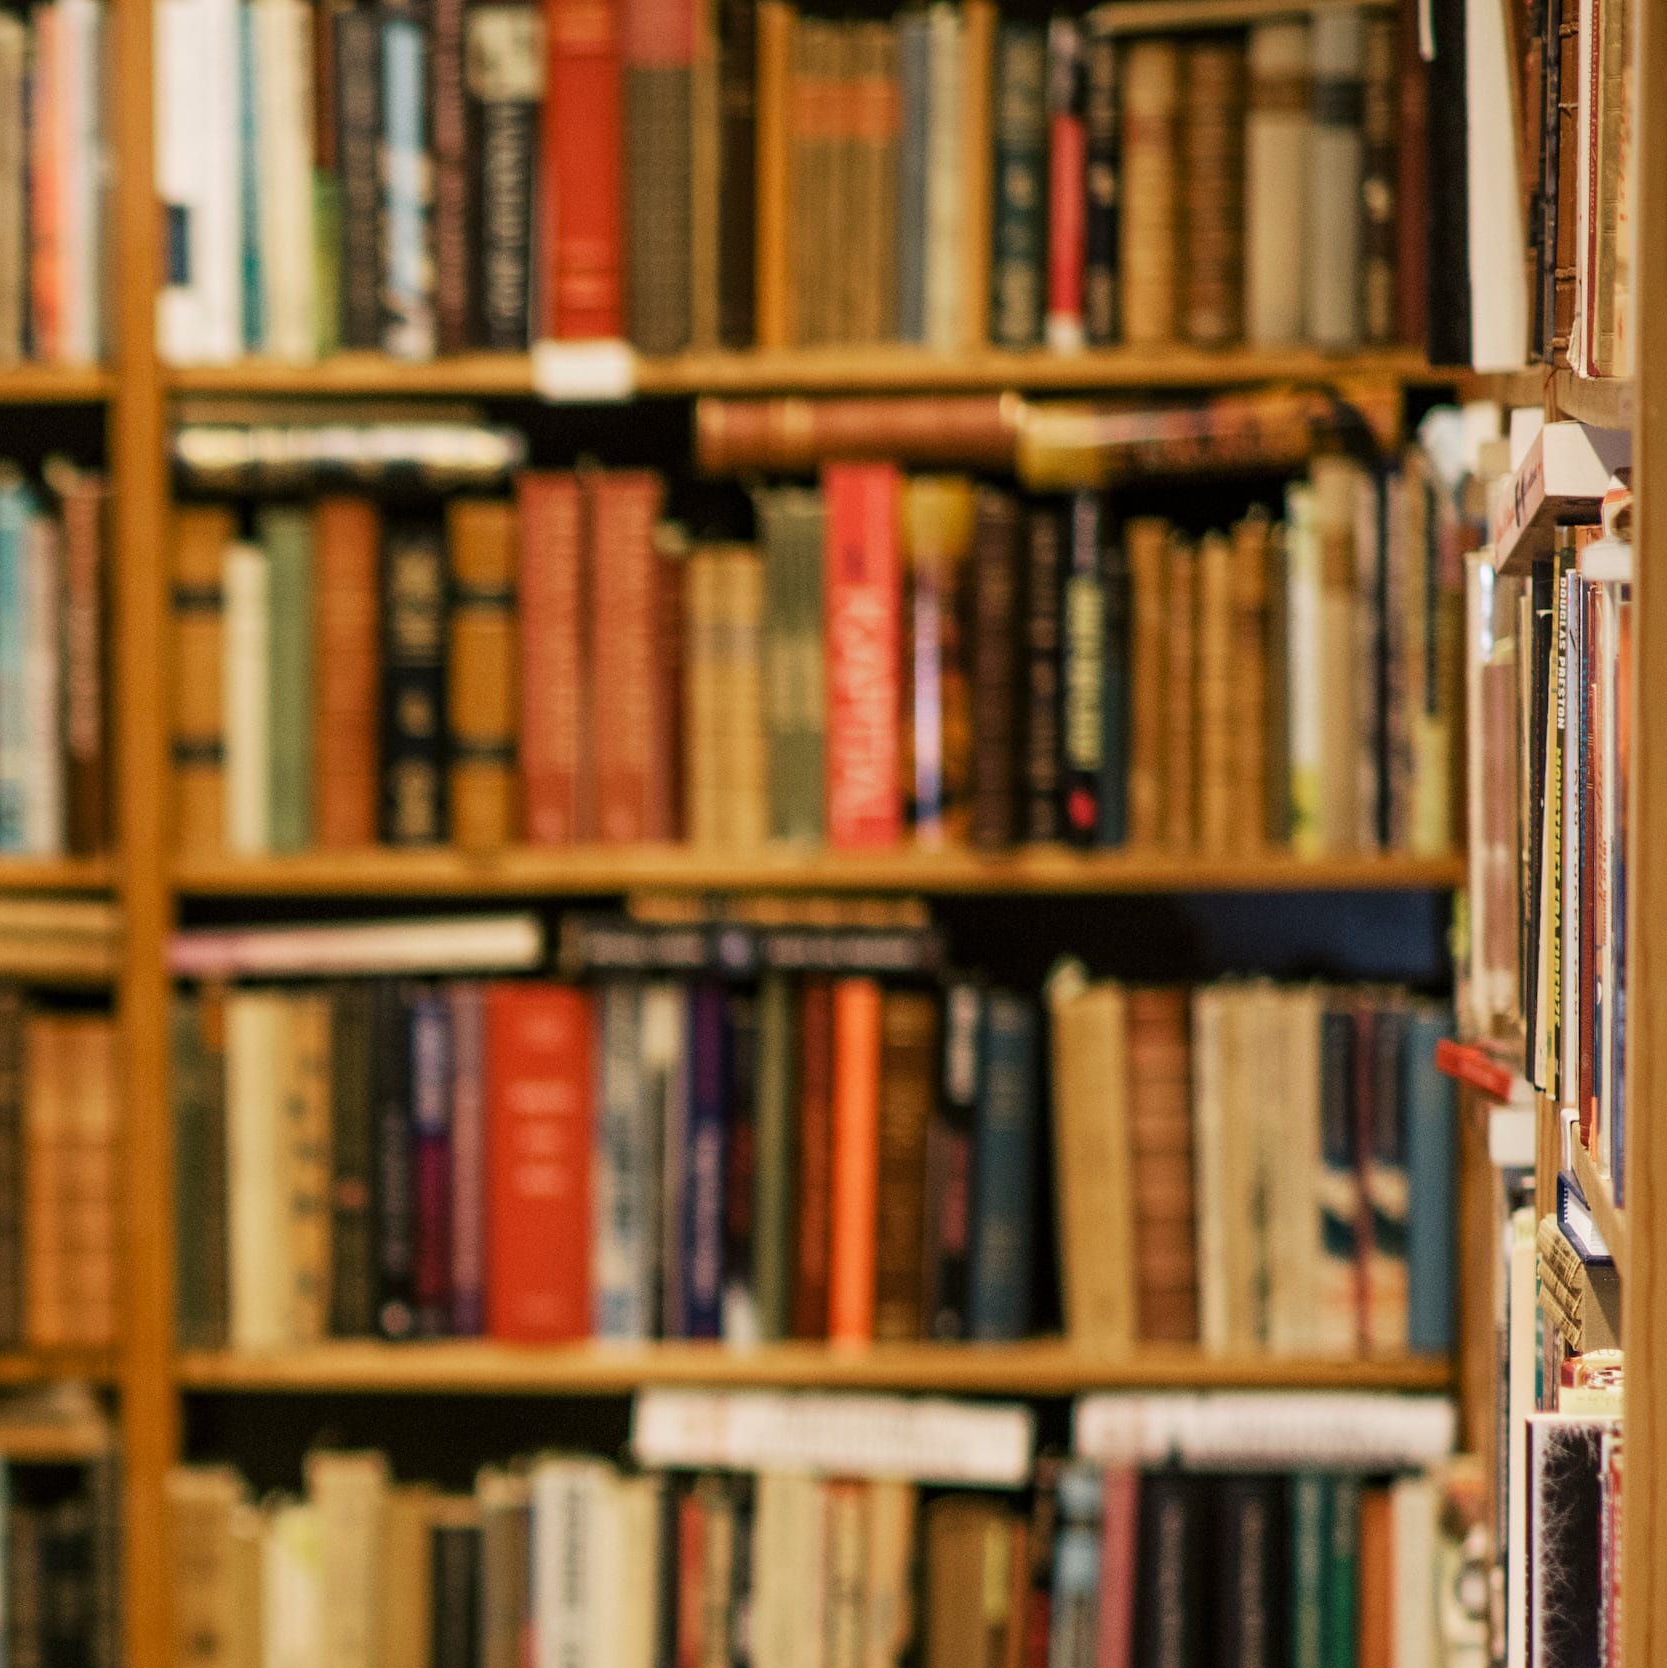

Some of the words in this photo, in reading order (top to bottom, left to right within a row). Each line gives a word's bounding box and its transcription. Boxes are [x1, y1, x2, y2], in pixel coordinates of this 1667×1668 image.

[1589, 147, 1597, 234] Zaragoza
[1558, 576, 1567, 650] DOUGLAS
[1557, 655, 1566, 730] PRESTON
[1554, 747, 1563, 882] MONSTERET
[1553, 936, 1561, 1028] FIRENZE
